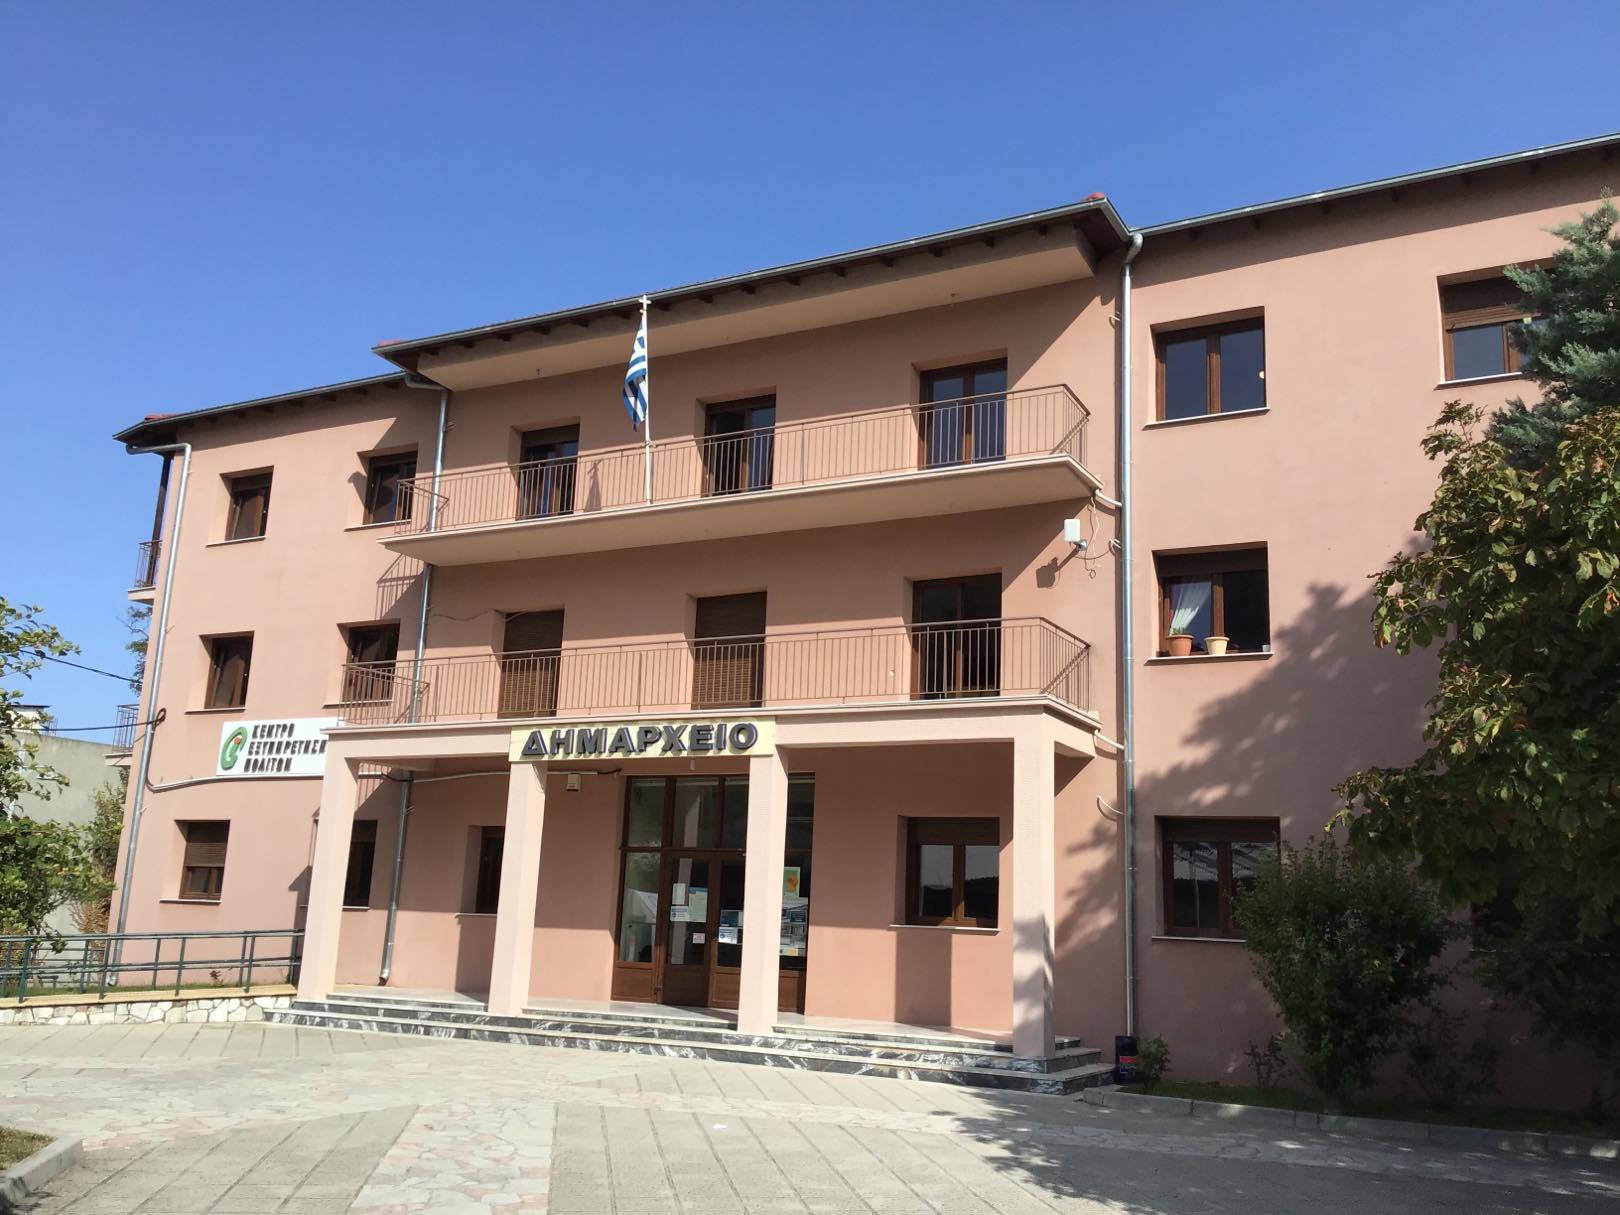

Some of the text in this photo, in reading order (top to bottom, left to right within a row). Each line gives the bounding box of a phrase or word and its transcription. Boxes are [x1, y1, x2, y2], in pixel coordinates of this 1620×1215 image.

[252, 723, 295, 739] ΚΕΝΤΡΟ
[247, 739, 328, 756] ΕΞΥΠΗΡΕΤΗΣΗ
[520, 723, 759, 756] ΔΗΜΑΡΧΕΙΟ
[243, 757, 293, 773] ΠΟΛΙΤΩΝ
